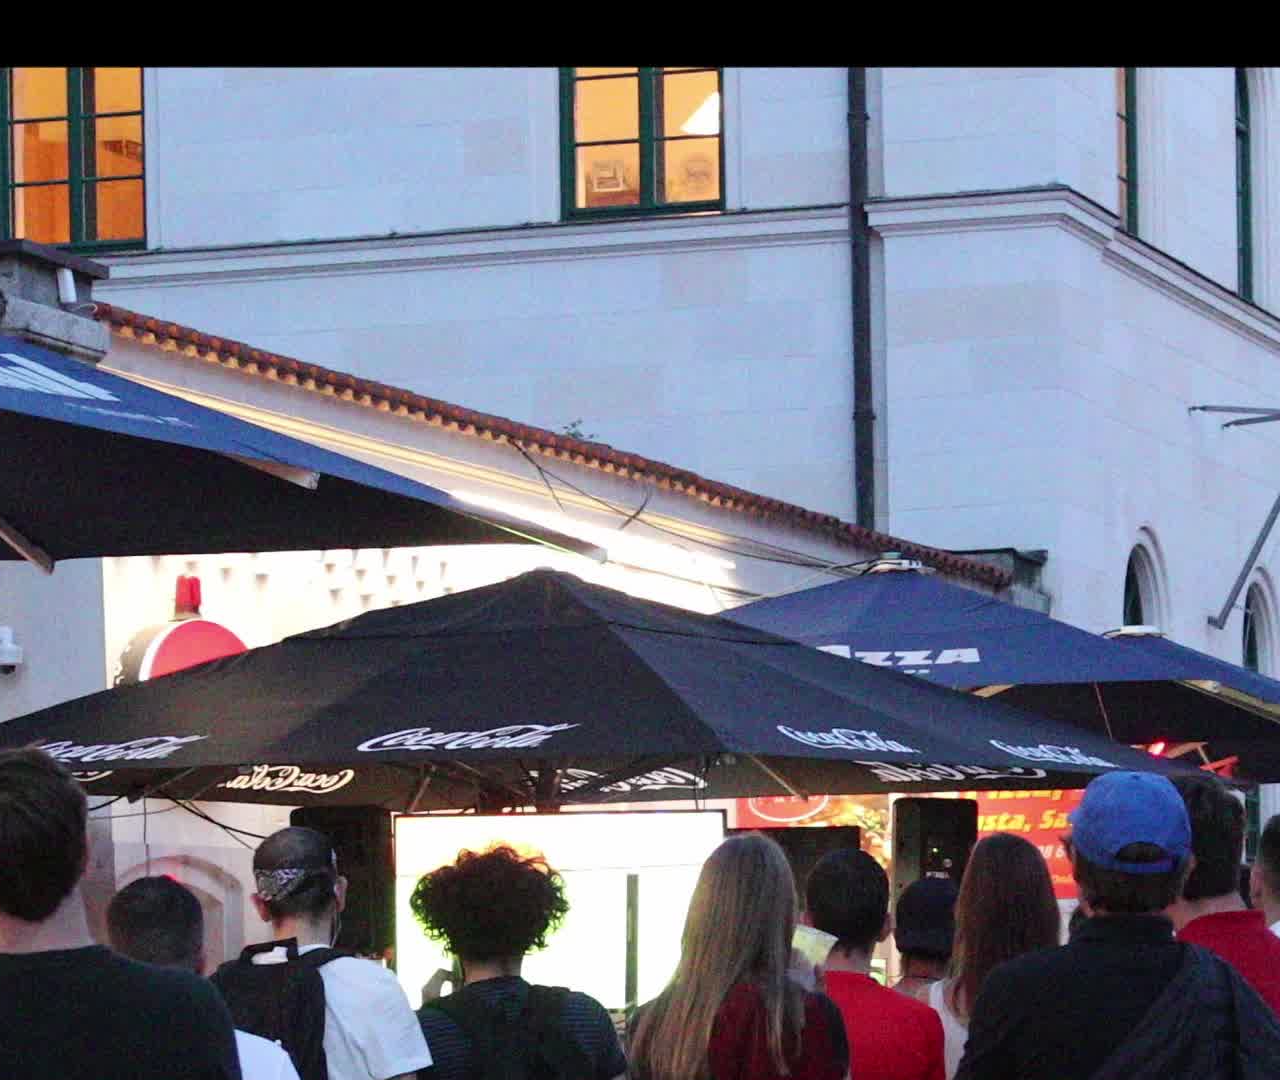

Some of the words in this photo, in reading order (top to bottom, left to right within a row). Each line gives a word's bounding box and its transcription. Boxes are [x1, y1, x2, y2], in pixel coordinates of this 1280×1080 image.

[356, 723, 582, 752] Coca-Cola
[776, 725, 923, 754] Coca-Cola
[977, 813, 1032, 833] sta,
